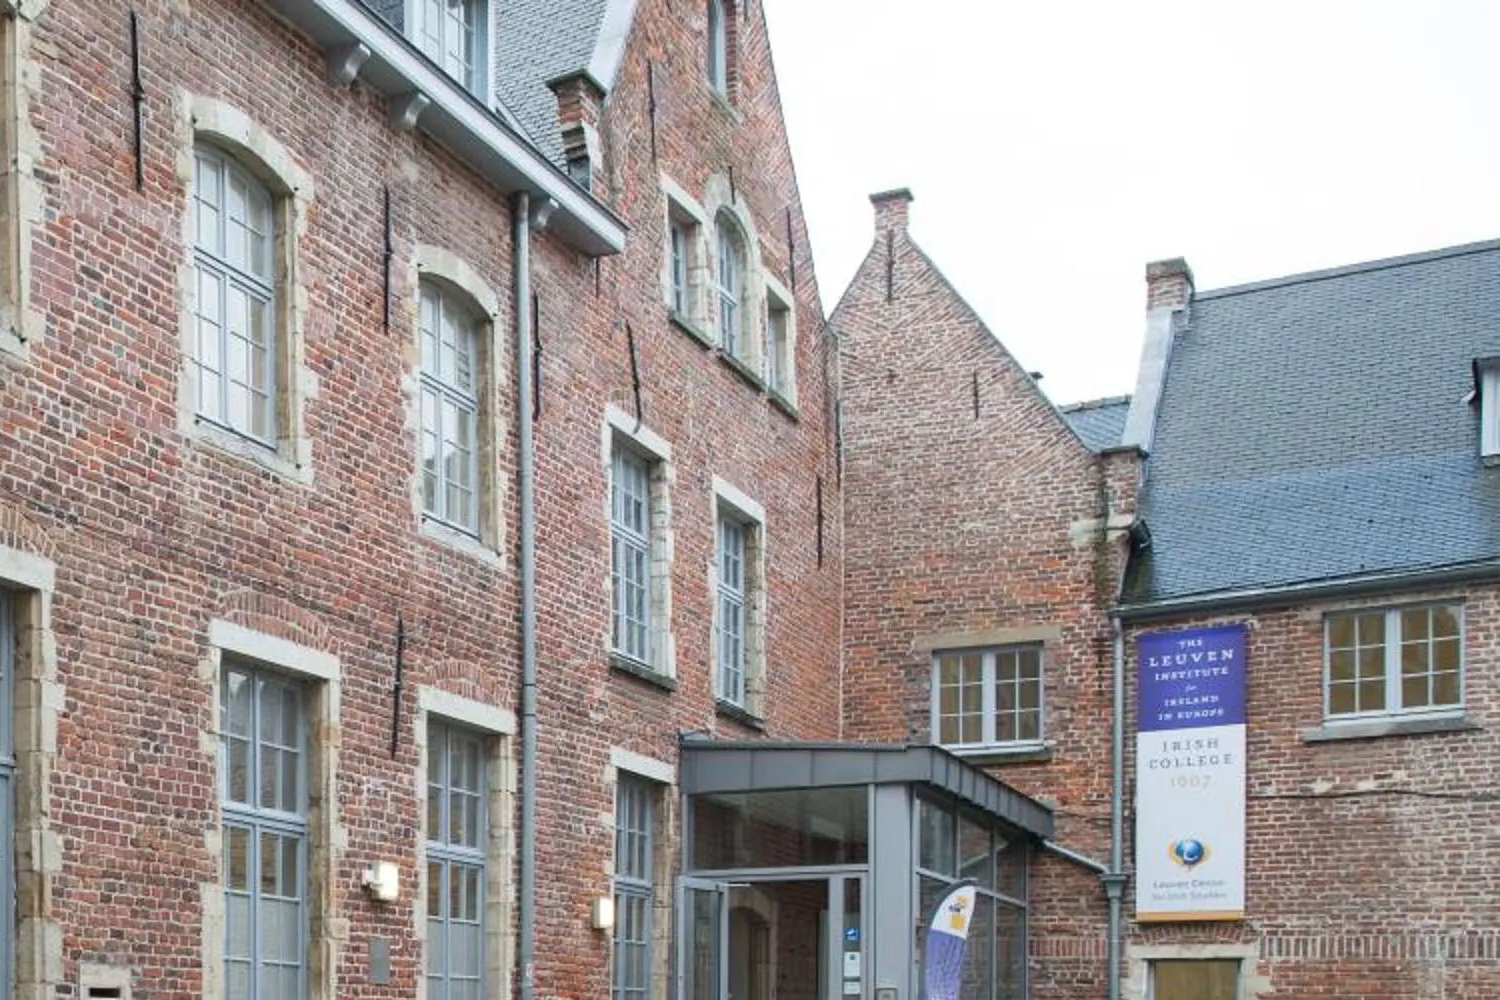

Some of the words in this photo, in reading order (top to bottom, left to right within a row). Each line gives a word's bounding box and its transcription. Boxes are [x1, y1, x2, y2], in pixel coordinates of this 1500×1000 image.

[1178, 638, 1203, 649] THE
[1146, 649, 1234, 667] LEUVEN
[1155, 667, 1229, 680] INSTITUTE
[1164, 695, 1219, 707] IRELAND
[1177, 708, 1224, 719] EUROPE
[1163, 738, 1218, 752] IRISH
[1149, 753, 1233, 769] COLLEGE
